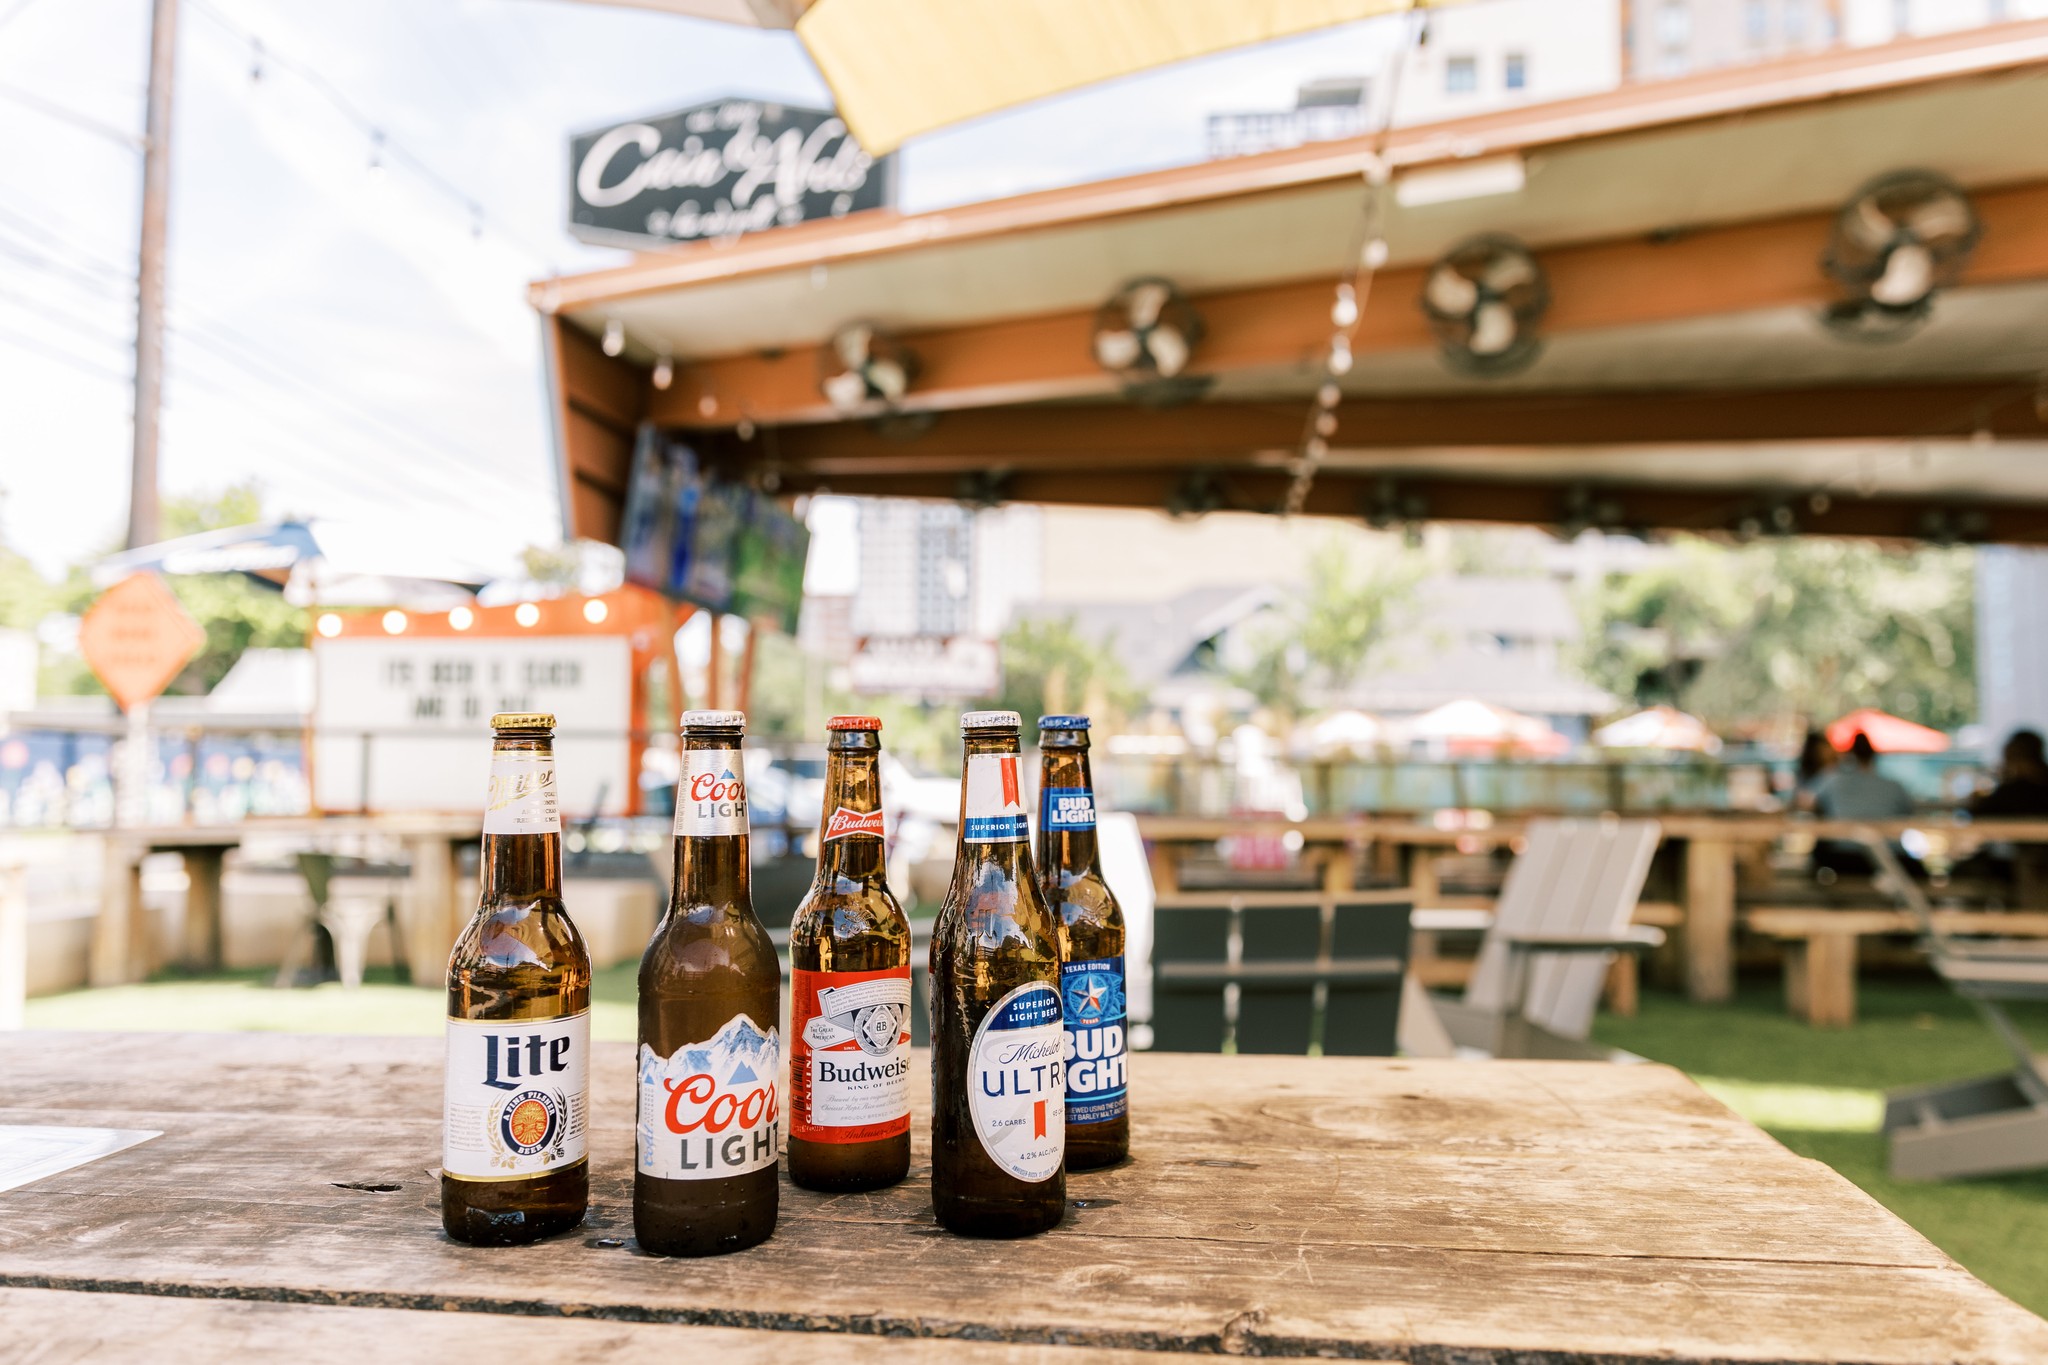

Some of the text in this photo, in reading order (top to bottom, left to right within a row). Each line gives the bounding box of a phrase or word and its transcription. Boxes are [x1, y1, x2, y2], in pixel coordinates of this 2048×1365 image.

[690, 773, 746, 802] Coor
[698, 802, 746, 819] LIGH
[1058, 797, 1091, 811] BUD
[1052, 809, 1096, 823] LIGHT
[971, 823, 1010, 831] SUPERIOR
[1064, 963, 1111, 973] TEXAS EDITION
[1013, 997, 1055, 1011] SUPERIOR
[1009, 1007, 1057, 1023] LIGHT BEER
[481, 1034, 570, 1091] Lite
[819, 1056, 910, 1083] Budweise
[805, 1049, 813, 1124] GENUINE
[506, 1094, 526, 1113] FINE
[528, 1092, 555, 1115] PILSNER
[663, 1073, 778, 1135] Coor
[992, 1118, 1026, 1127] 2.6 CARBS
[1077, 1111, 1100, 1121] BARLEY
[518, 1144, 543, 1155] BEER
[1020, 1151, 1037, 1160] 4.2%
